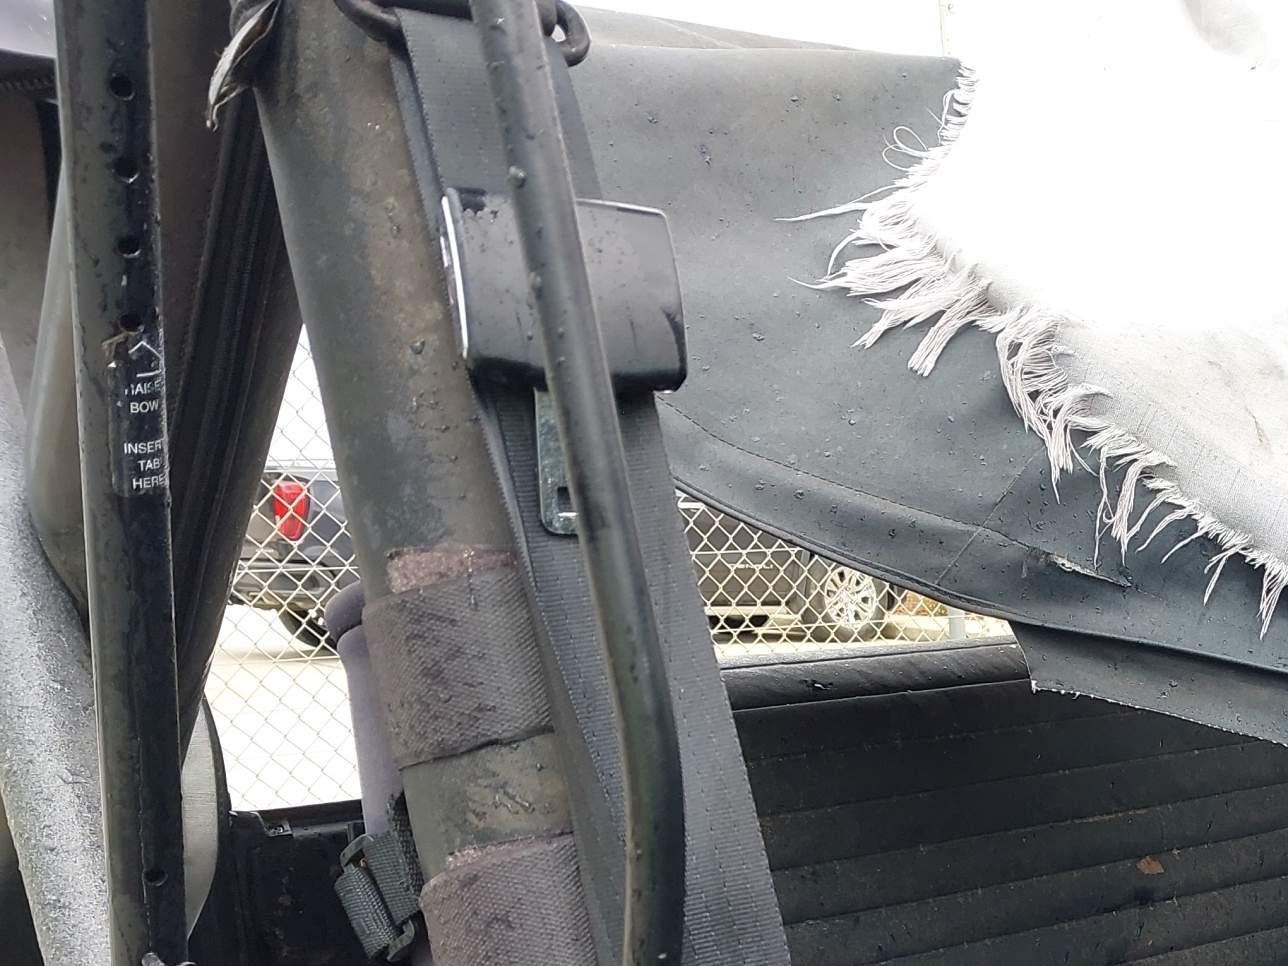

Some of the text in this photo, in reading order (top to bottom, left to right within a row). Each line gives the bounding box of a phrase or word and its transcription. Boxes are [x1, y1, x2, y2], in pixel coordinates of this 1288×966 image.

[130, 399, 159, 414] BOW
[137, 457, 161, 472] TAB
[132, 473, 167, 489] HERE
